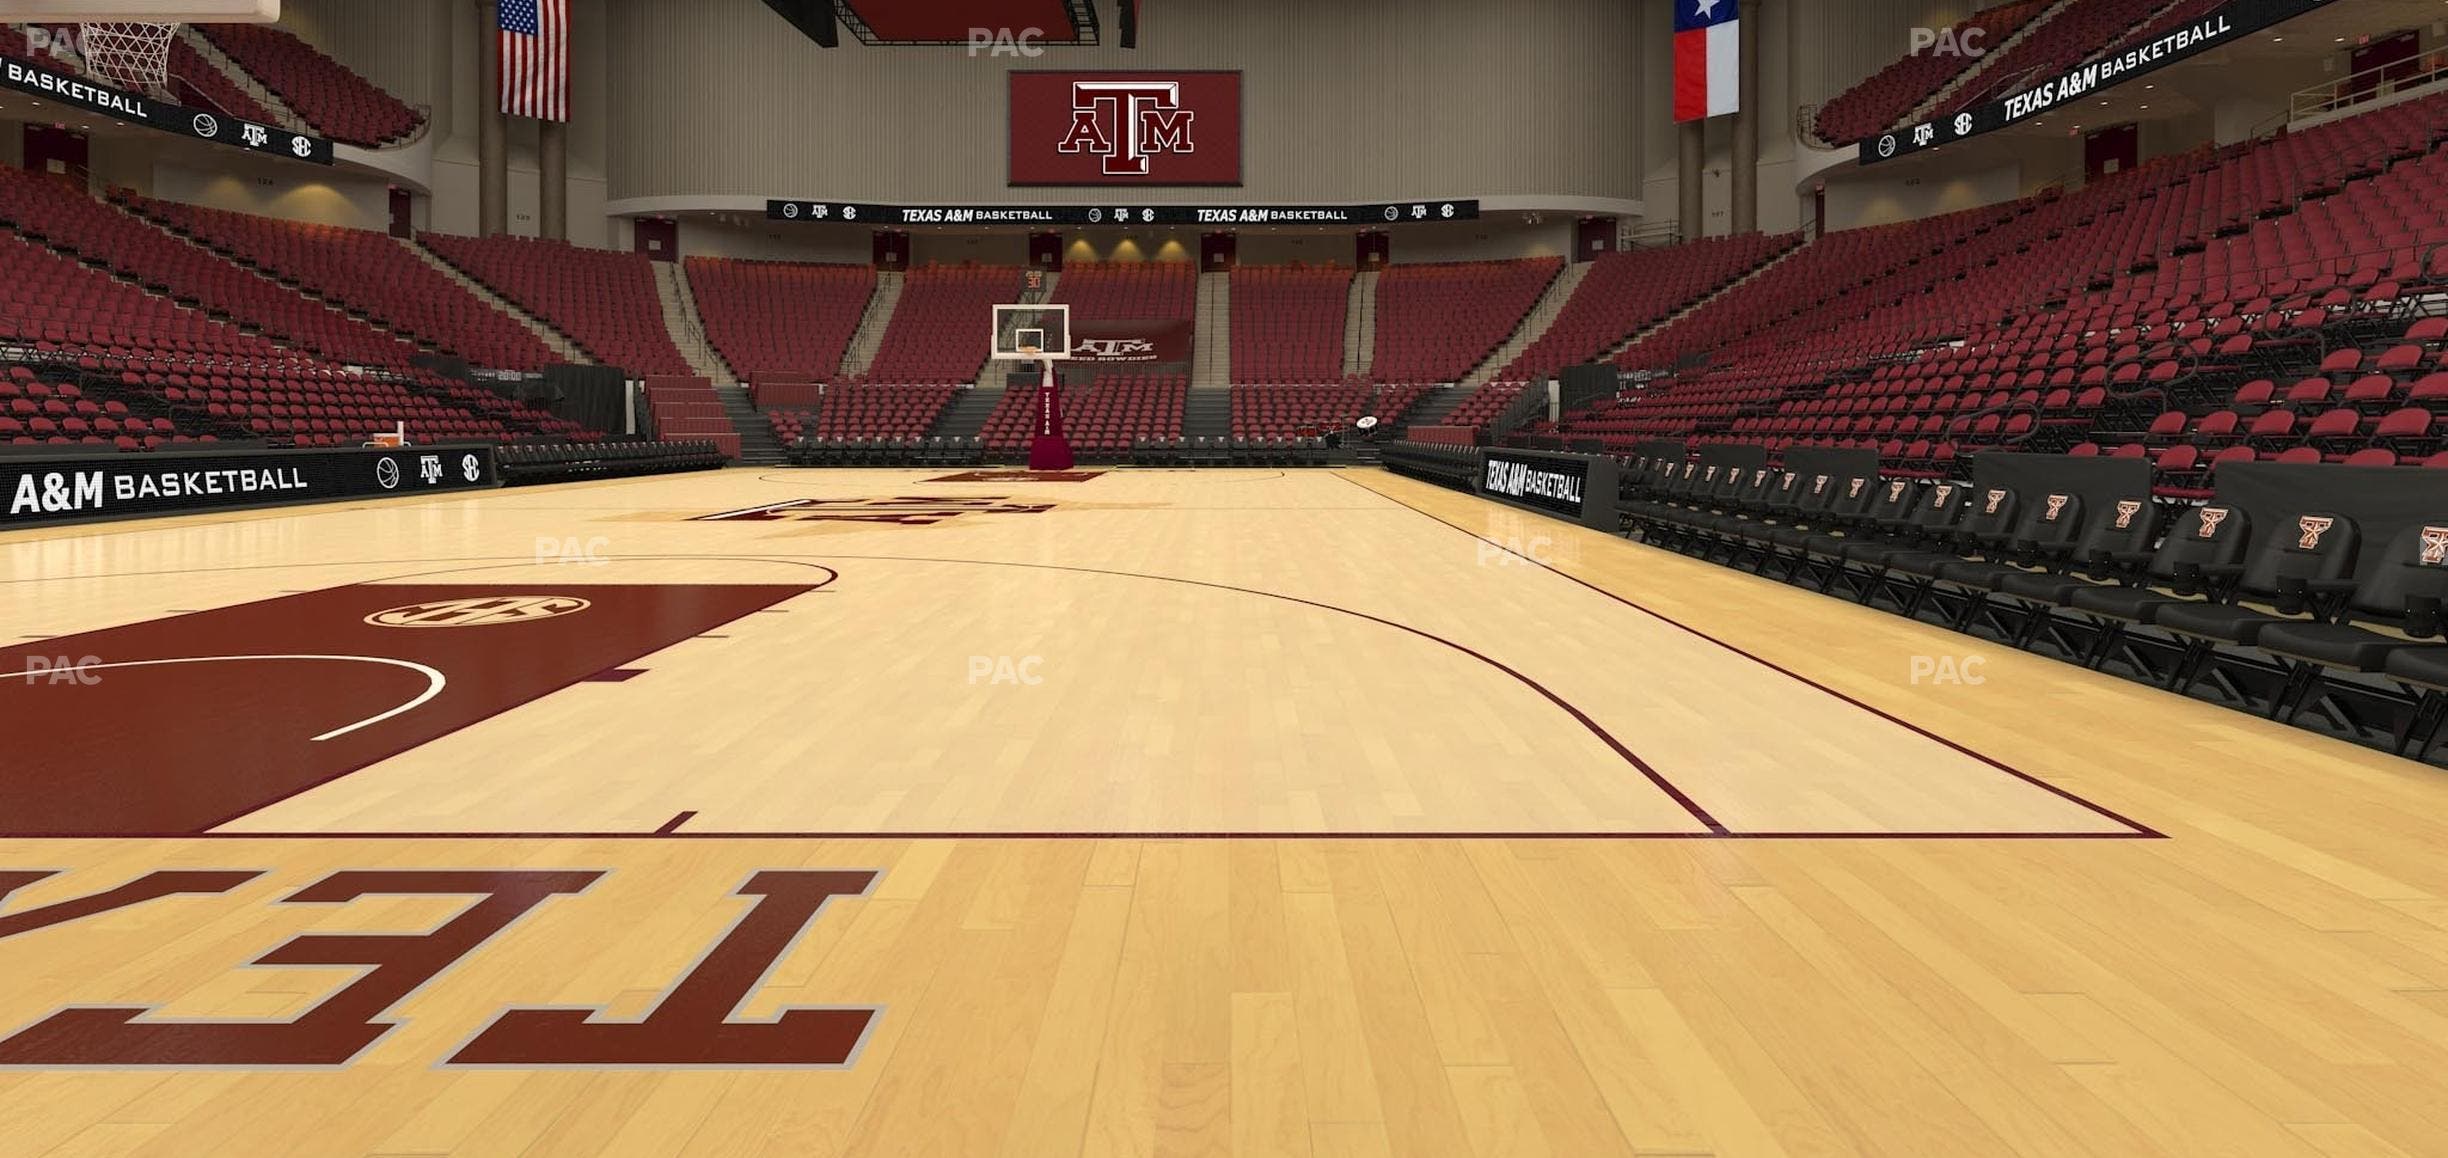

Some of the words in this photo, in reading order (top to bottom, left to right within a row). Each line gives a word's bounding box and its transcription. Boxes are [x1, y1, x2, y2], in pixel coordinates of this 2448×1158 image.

[8, 63, 148, 118] BASKETBALL
[2004, 82, 2054, 122] TEXAS
[2056, 64, 2098, 102] A&M
[2101, 15, 2231, 80] BASKETBALL
[902, 209, 942, 222] TEXAS
[944, 209, 974, 222] A&M
[976, 210, 1053, 220] BASKETBALL
[1197, 209, 1237, 222] TEXAS
[1239, 209, 1268, 222] A&M
[1271, 210, 1348, 220] BASKETBALL
[9, 471, 104, 515] A&M
[114, 467, 308, 501] BASKETBALL
[1486, 459, 1510, 493] TEXAS
[1525, 469, 1581, 503] BASKETBALL
